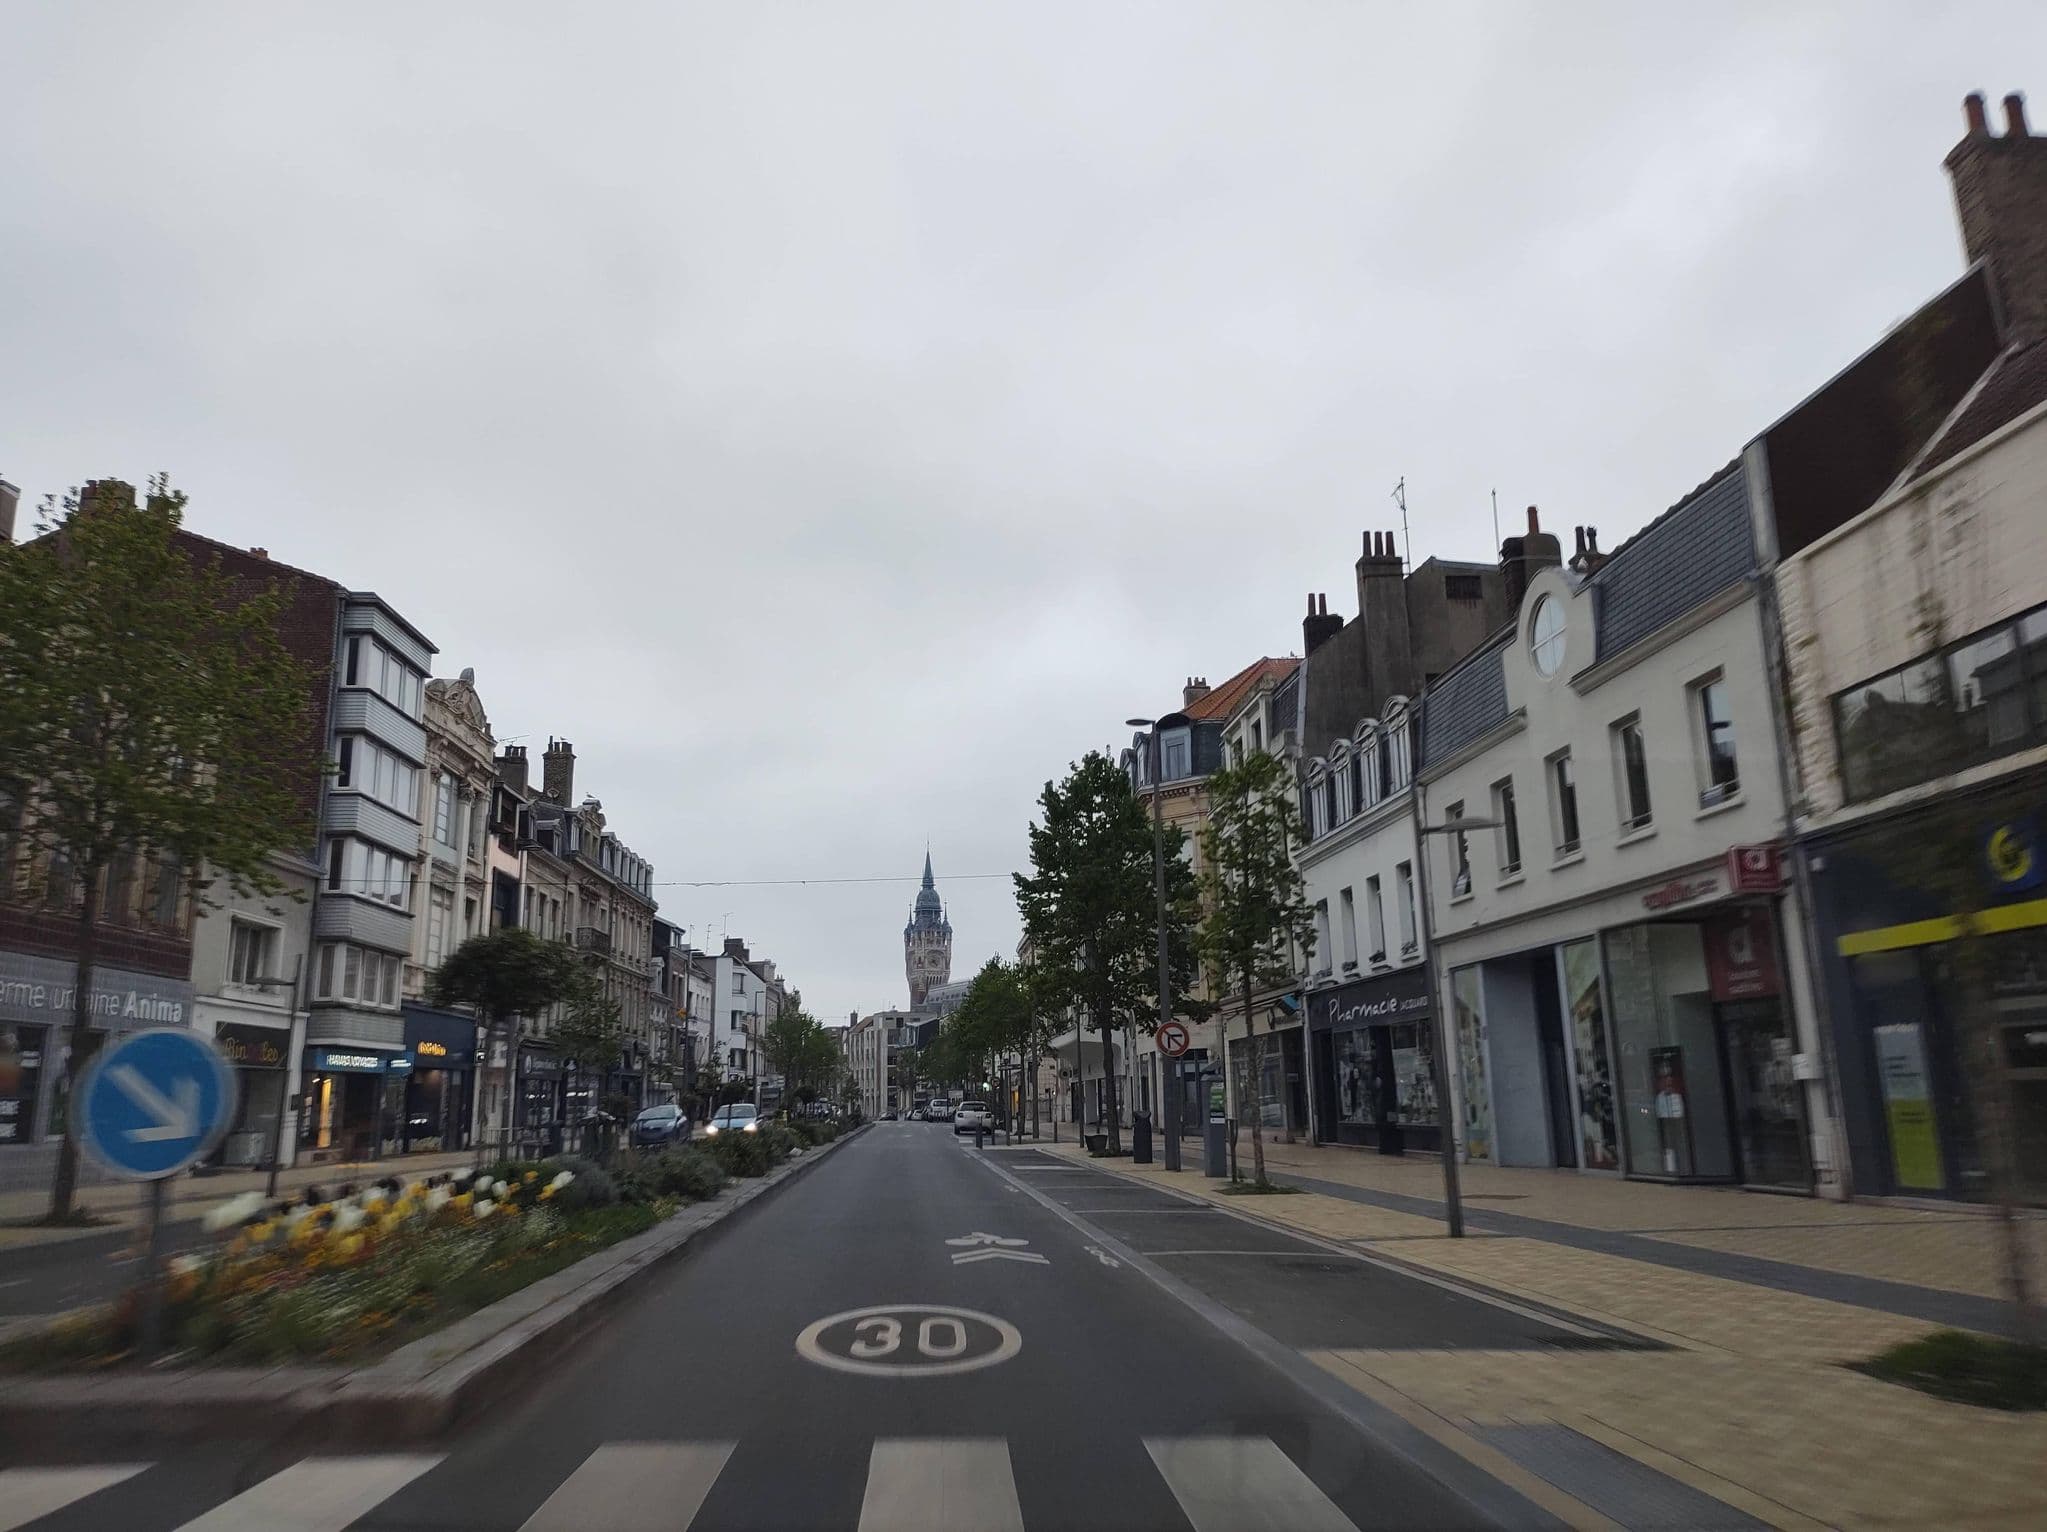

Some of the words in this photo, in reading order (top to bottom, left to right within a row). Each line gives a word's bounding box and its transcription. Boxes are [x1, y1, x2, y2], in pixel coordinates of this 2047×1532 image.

[122, 990, 184, 1023] Anima
[1328, 992, 1398, 1024] Pharmacie
[850, 1316, 967, 1358] 30
